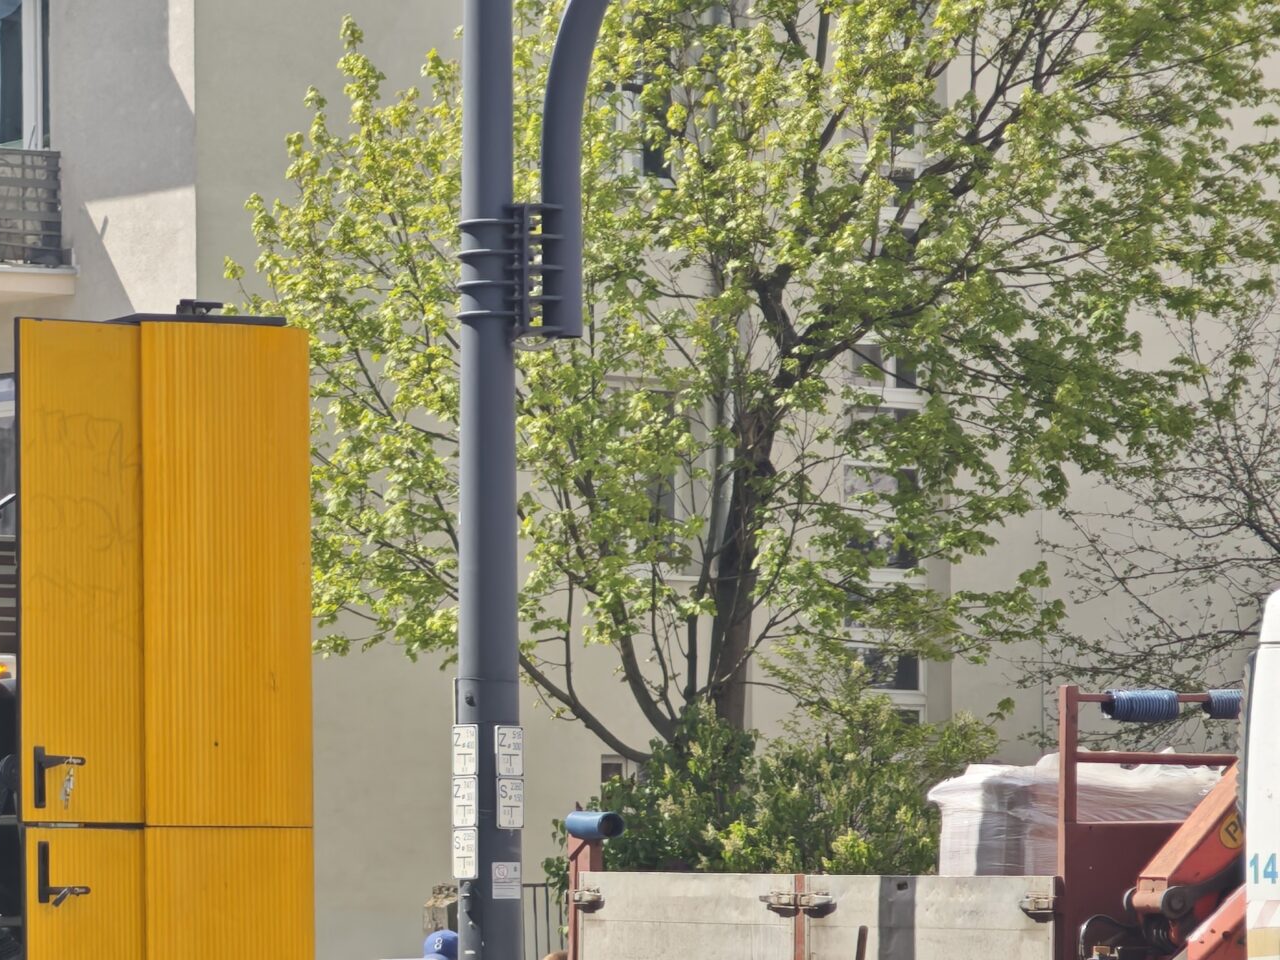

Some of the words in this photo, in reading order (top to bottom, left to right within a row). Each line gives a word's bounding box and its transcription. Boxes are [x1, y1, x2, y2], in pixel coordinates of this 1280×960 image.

[453, 732, 462, 747] Z
[499, 733, 507, 747] Z
[453, 784, 461, 798] Z
[500, 784, 508, 799] S
[454, 836, 461, 850] S
[1249, 853, 1279, 884] 14
